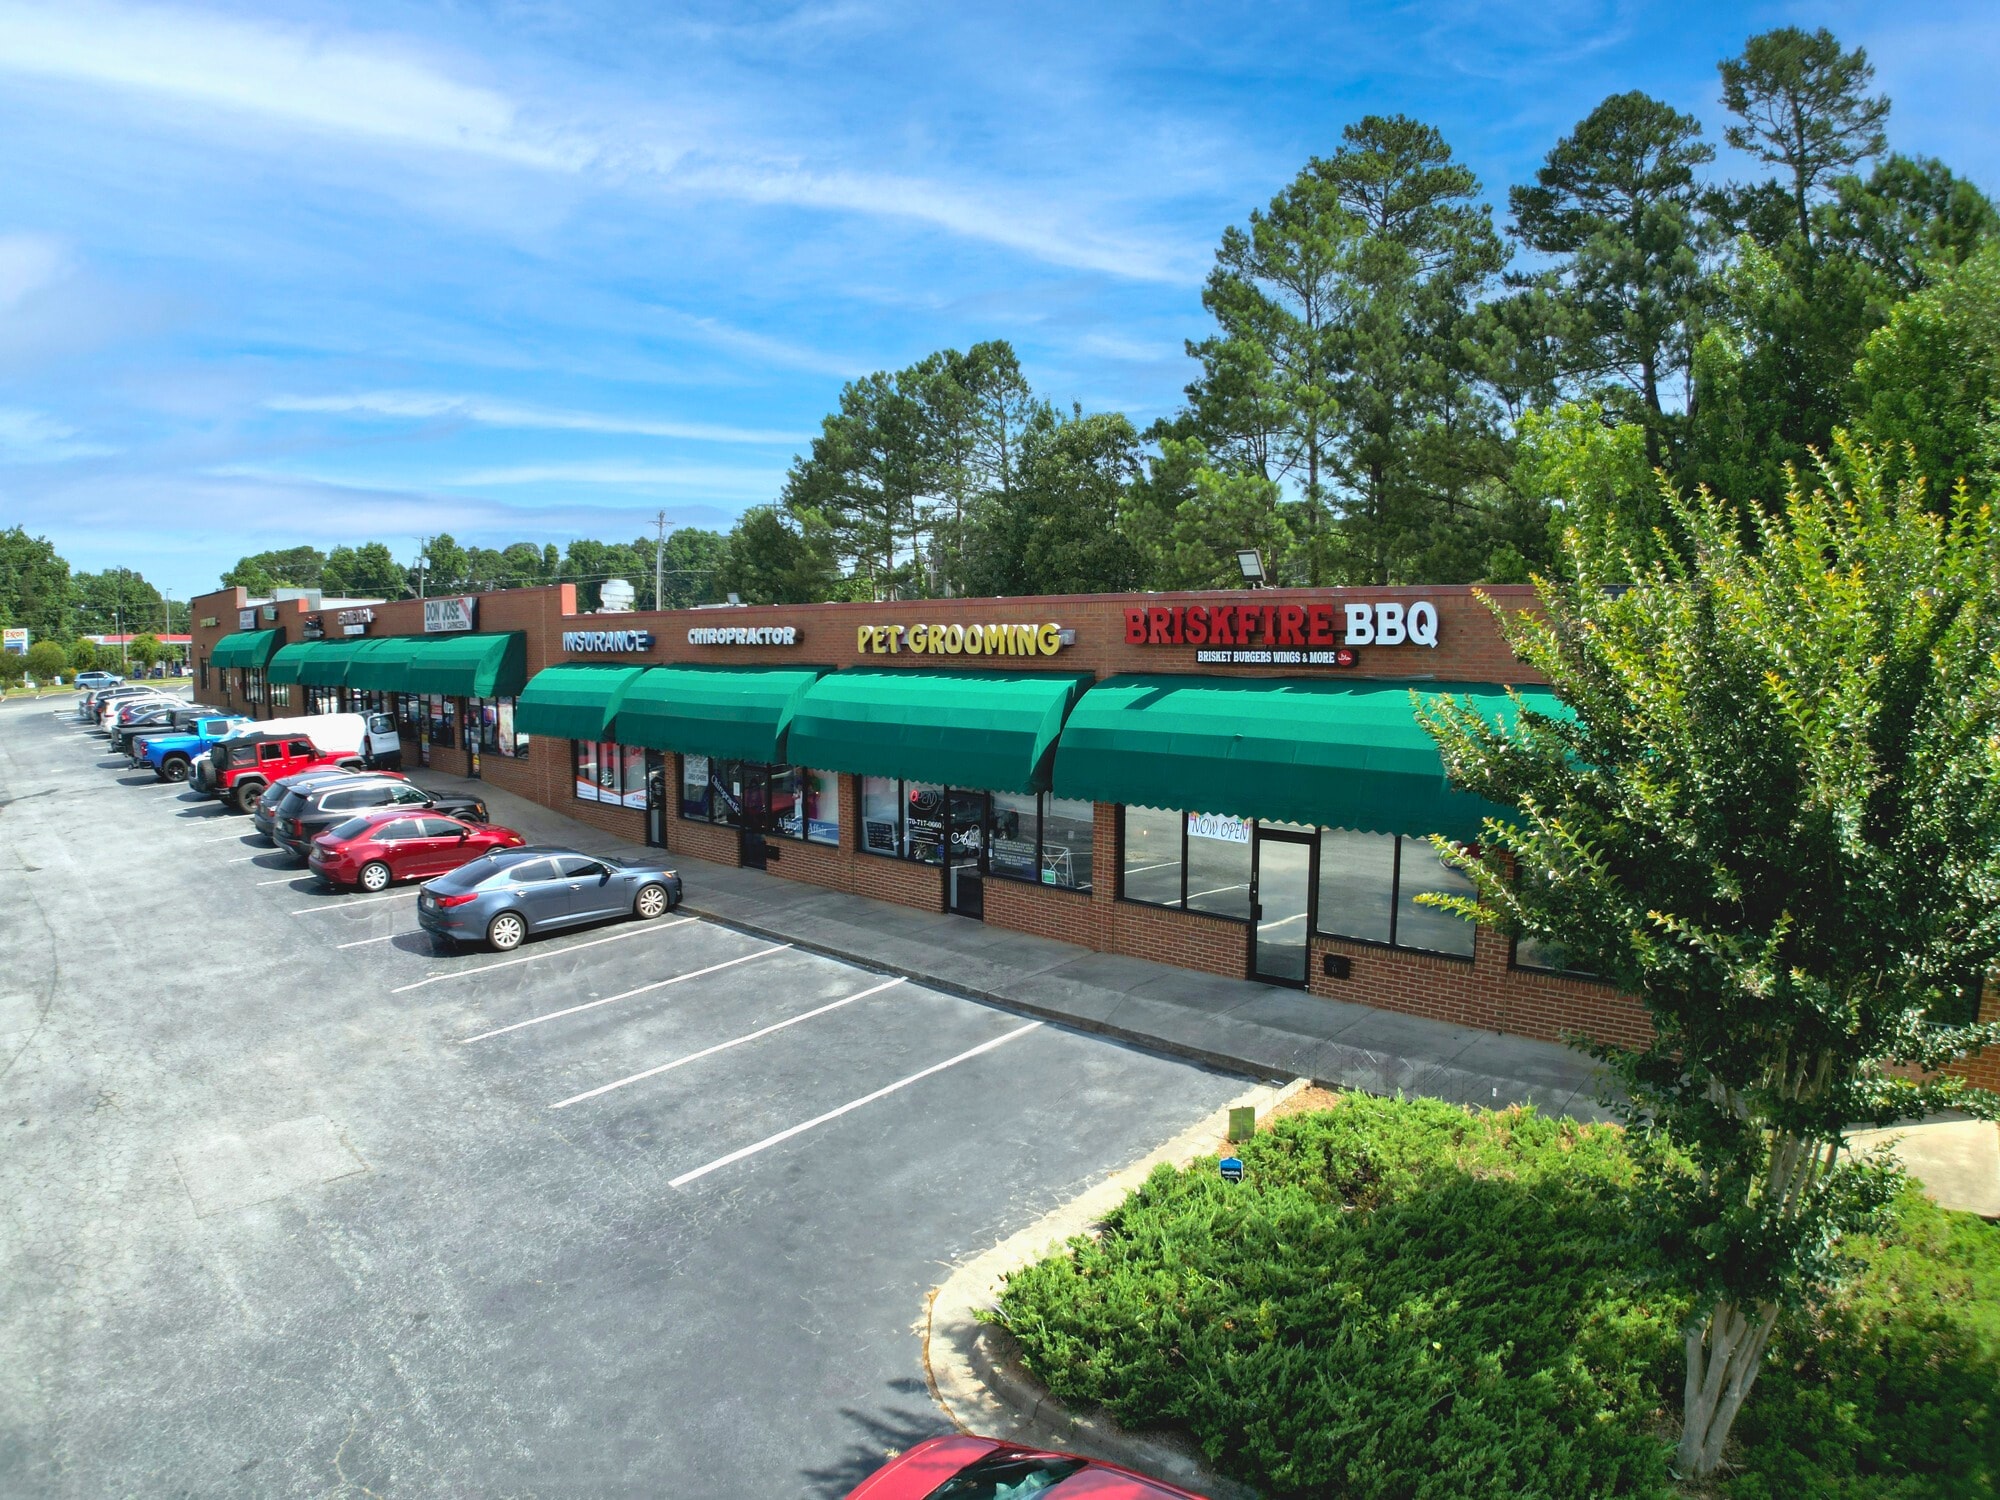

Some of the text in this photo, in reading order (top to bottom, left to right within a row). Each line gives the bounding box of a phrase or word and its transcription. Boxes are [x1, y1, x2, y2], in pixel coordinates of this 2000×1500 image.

[426, 600, 460, 621] DON JOSE
[5, 630, 25, 638] Exxon
[1124, 601, 1439, 649] BRISKFIRE BBQ
[562, 629, 649, 653] INSURANCE
[687, 626, 797, 646] CHIROPRACTOR
[857, 623, 1061, 656] PET GROOMING
[1197, 651, 1335, 664] BRISKET BURGERS WINGS & MORE
[910, 789, 935, 805] OPEN
[1191, 816, 1249, 840] NOW OPEN
